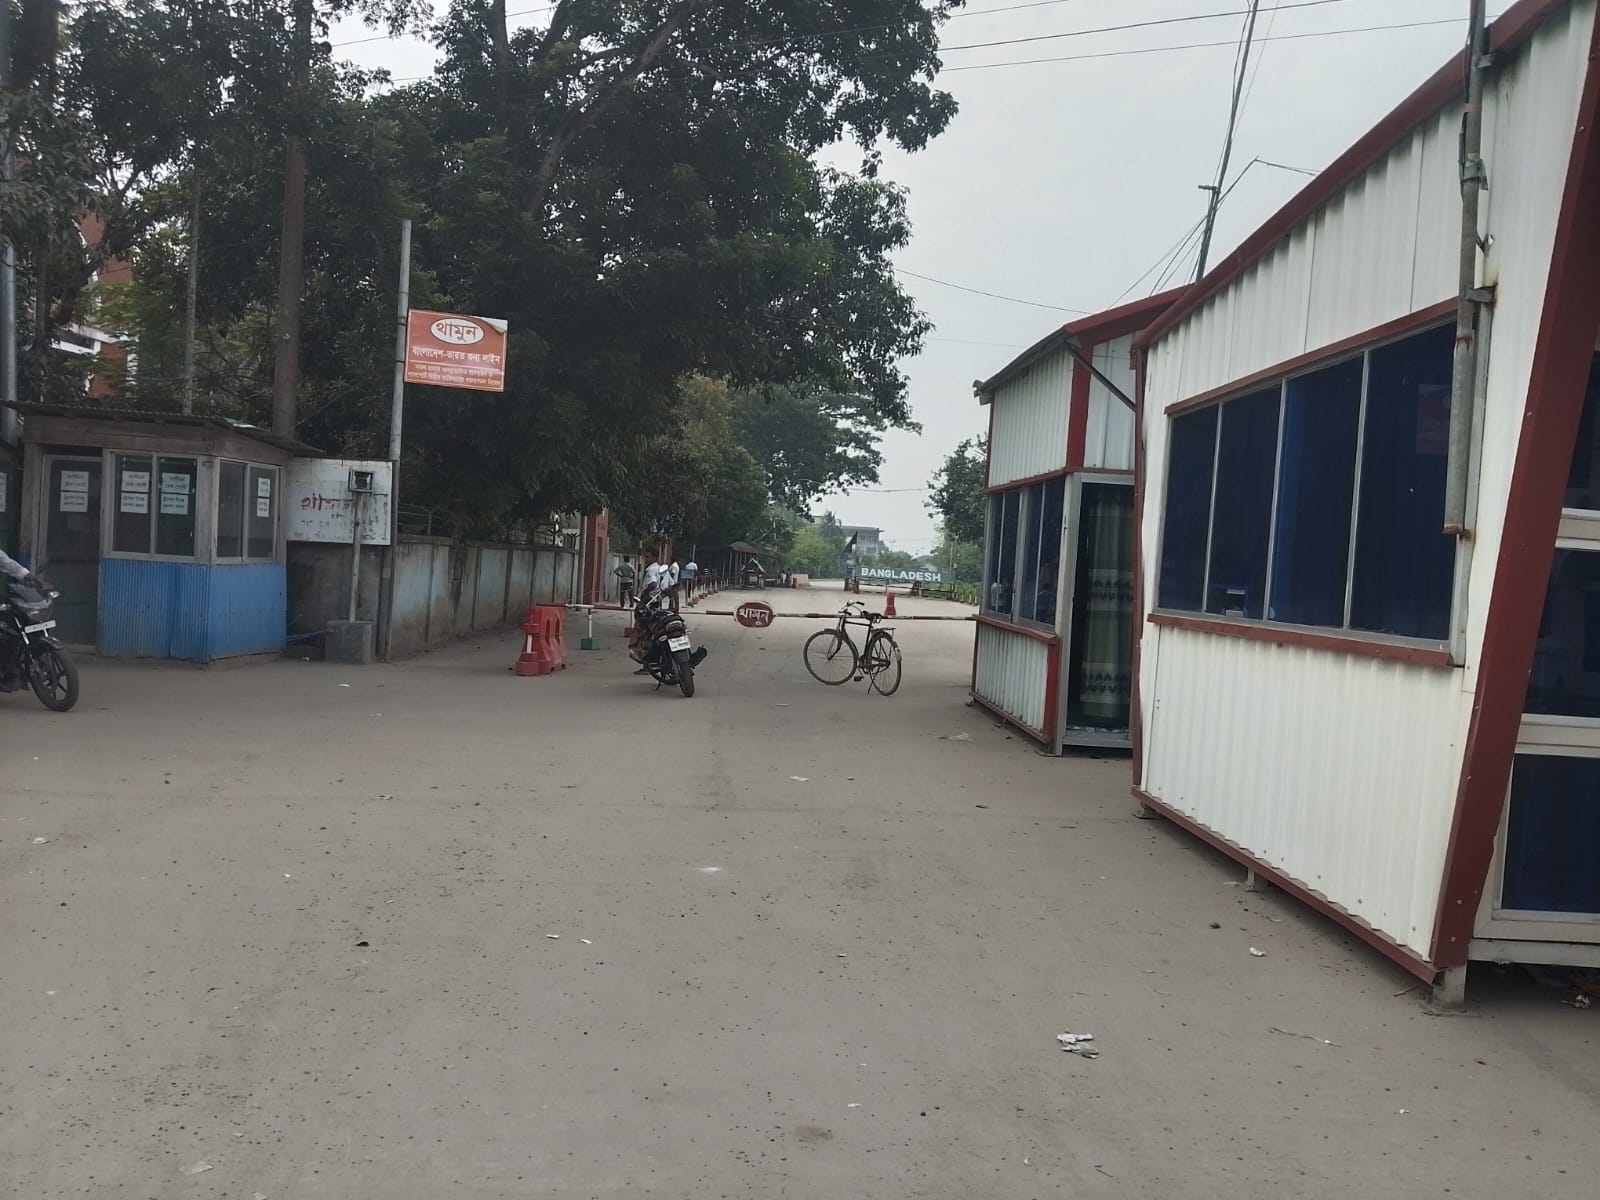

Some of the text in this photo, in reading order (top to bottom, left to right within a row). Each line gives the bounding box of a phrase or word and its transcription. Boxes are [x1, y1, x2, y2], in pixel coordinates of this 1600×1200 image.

[436, 322, 479, 342] থামুন
[861, 567, 941, 582] BANGLADESH
[739, 608, 770, 626] থামুন
